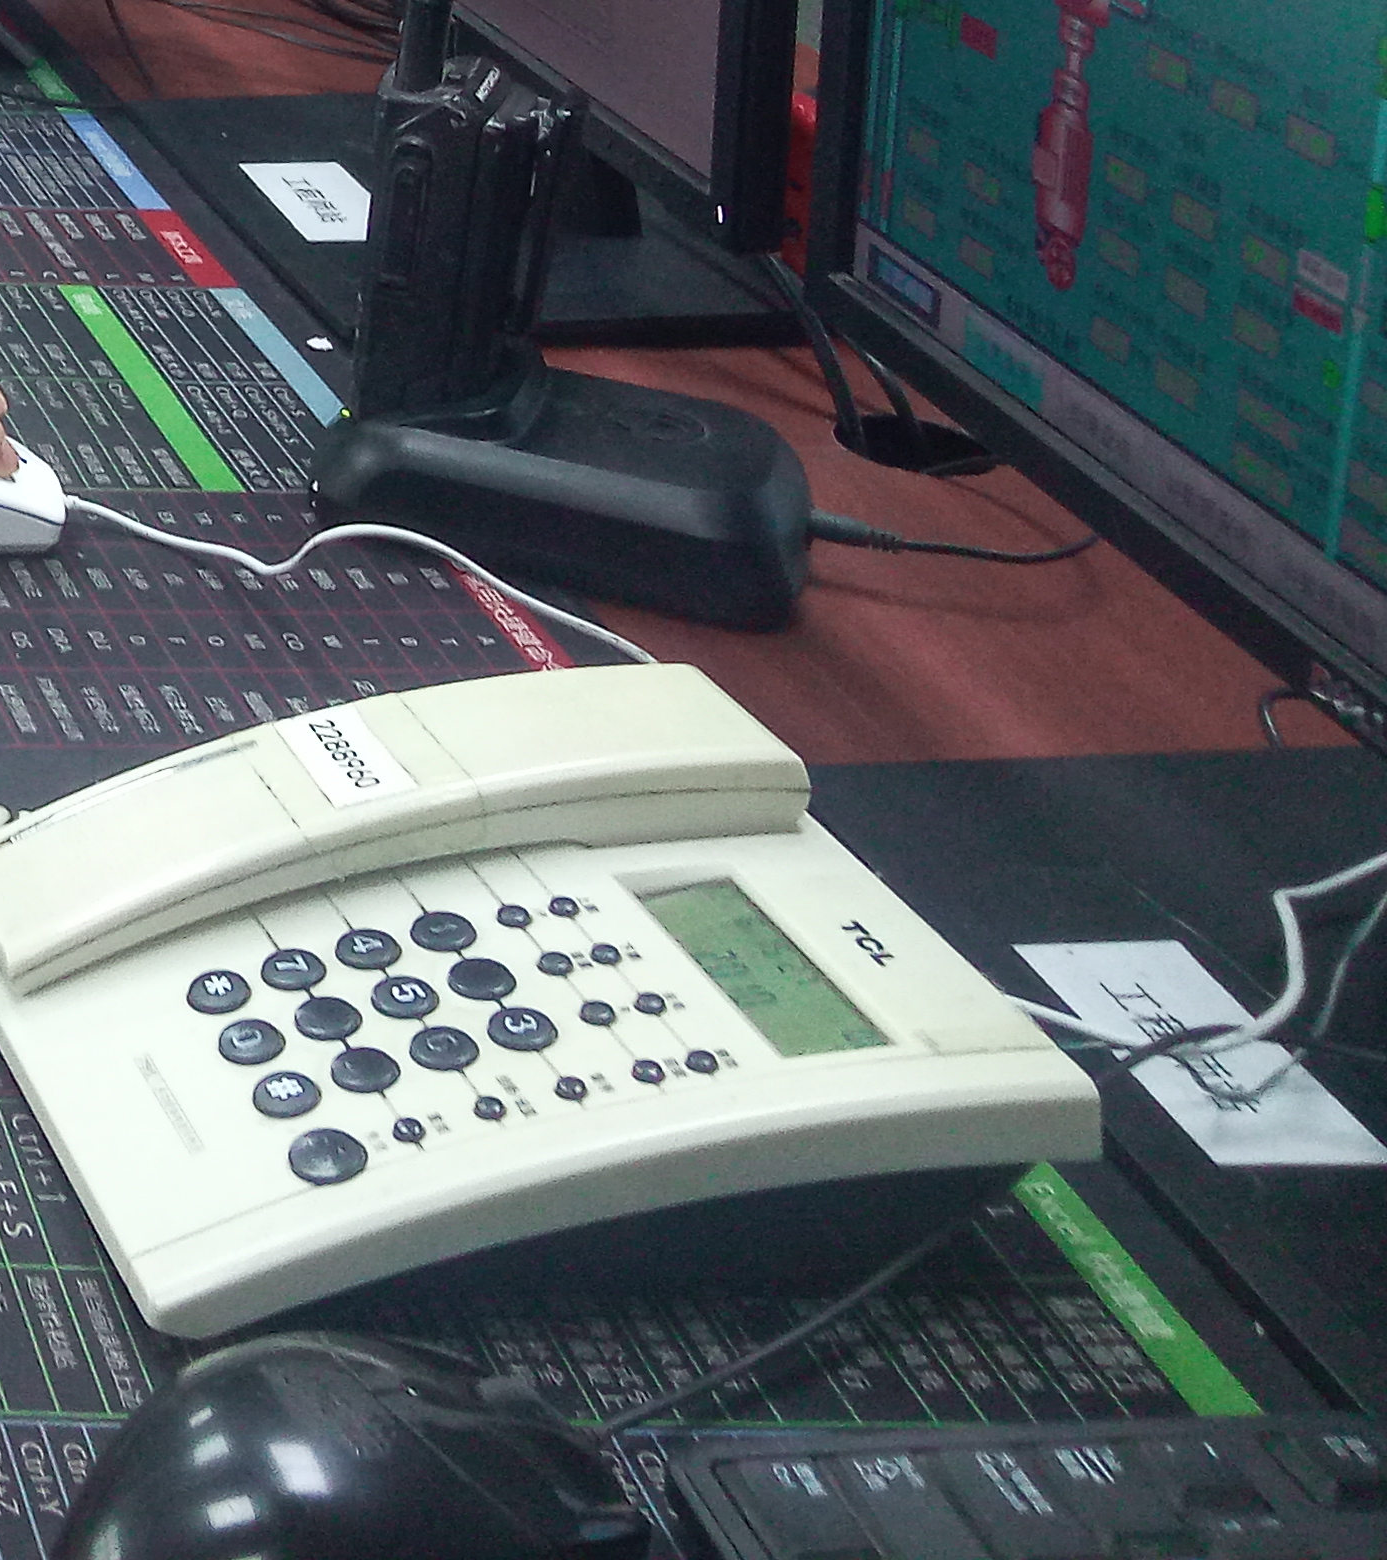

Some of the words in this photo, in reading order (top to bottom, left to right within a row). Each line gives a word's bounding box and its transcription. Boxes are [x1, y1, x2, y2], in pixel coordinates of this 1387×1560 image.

[308, 719, 381, 789] 2288960
[352, 935, 384, 955] 4
[840, 919, 895, 968] TCL
[274, 957, 311, 974] 7
[392, 981, 427, 1003] 5
[504, 1012, 538, 1034] 3
[265, 1075, 305, 1101] #
[20, 1440, 66, 1518] Ctrl+Y
